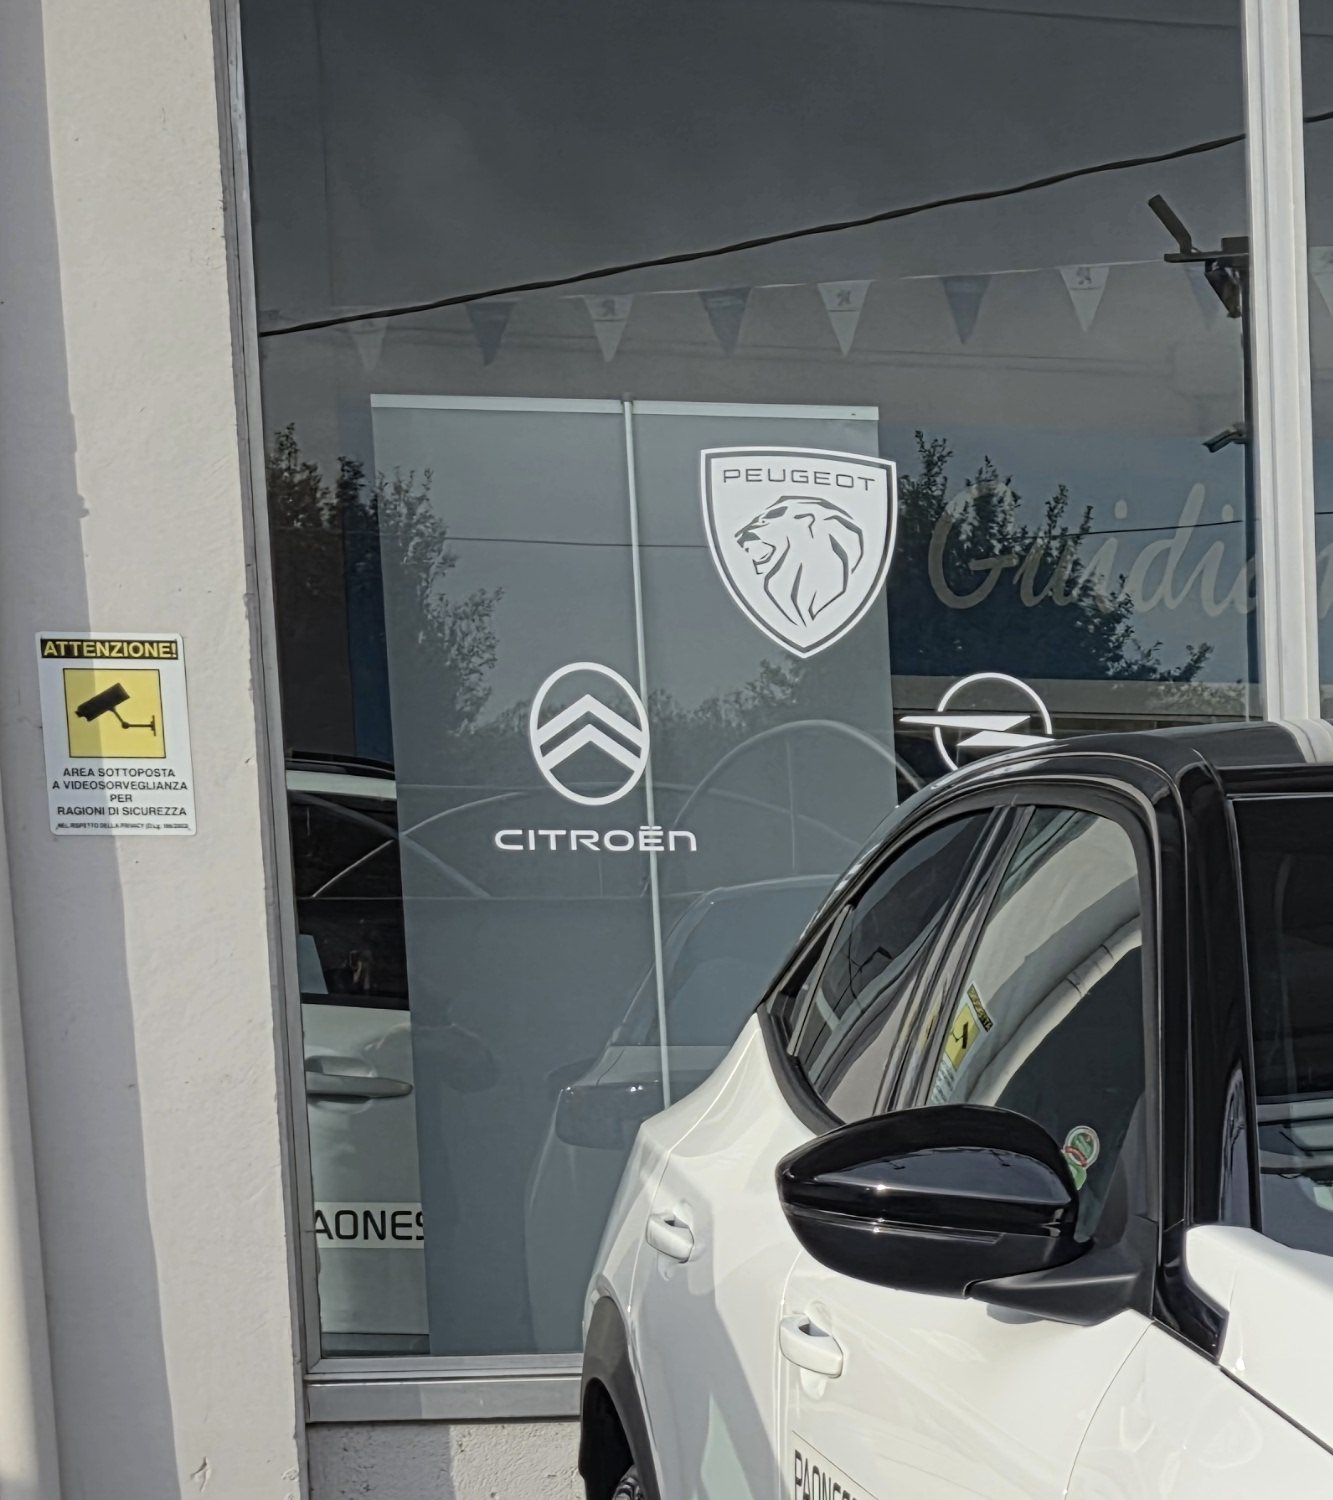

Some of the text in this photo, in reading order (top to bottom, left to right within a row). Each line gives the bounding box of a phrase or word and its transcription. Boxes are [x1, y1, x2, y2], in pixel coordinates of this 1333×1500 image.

[722, 467, 876, 492] PEUGEOT
[43, 640, 177, 658] ATTENZIONE!
[63, 767, 176, 778] AREA SOTTOPOSTA
[52, 780, 188, 791] A VIDEOSORVEGLIANZA
[109, 793, 133, 803] PER
[57, 806, 187, 816] RAGIONI DI SICUREZZA
